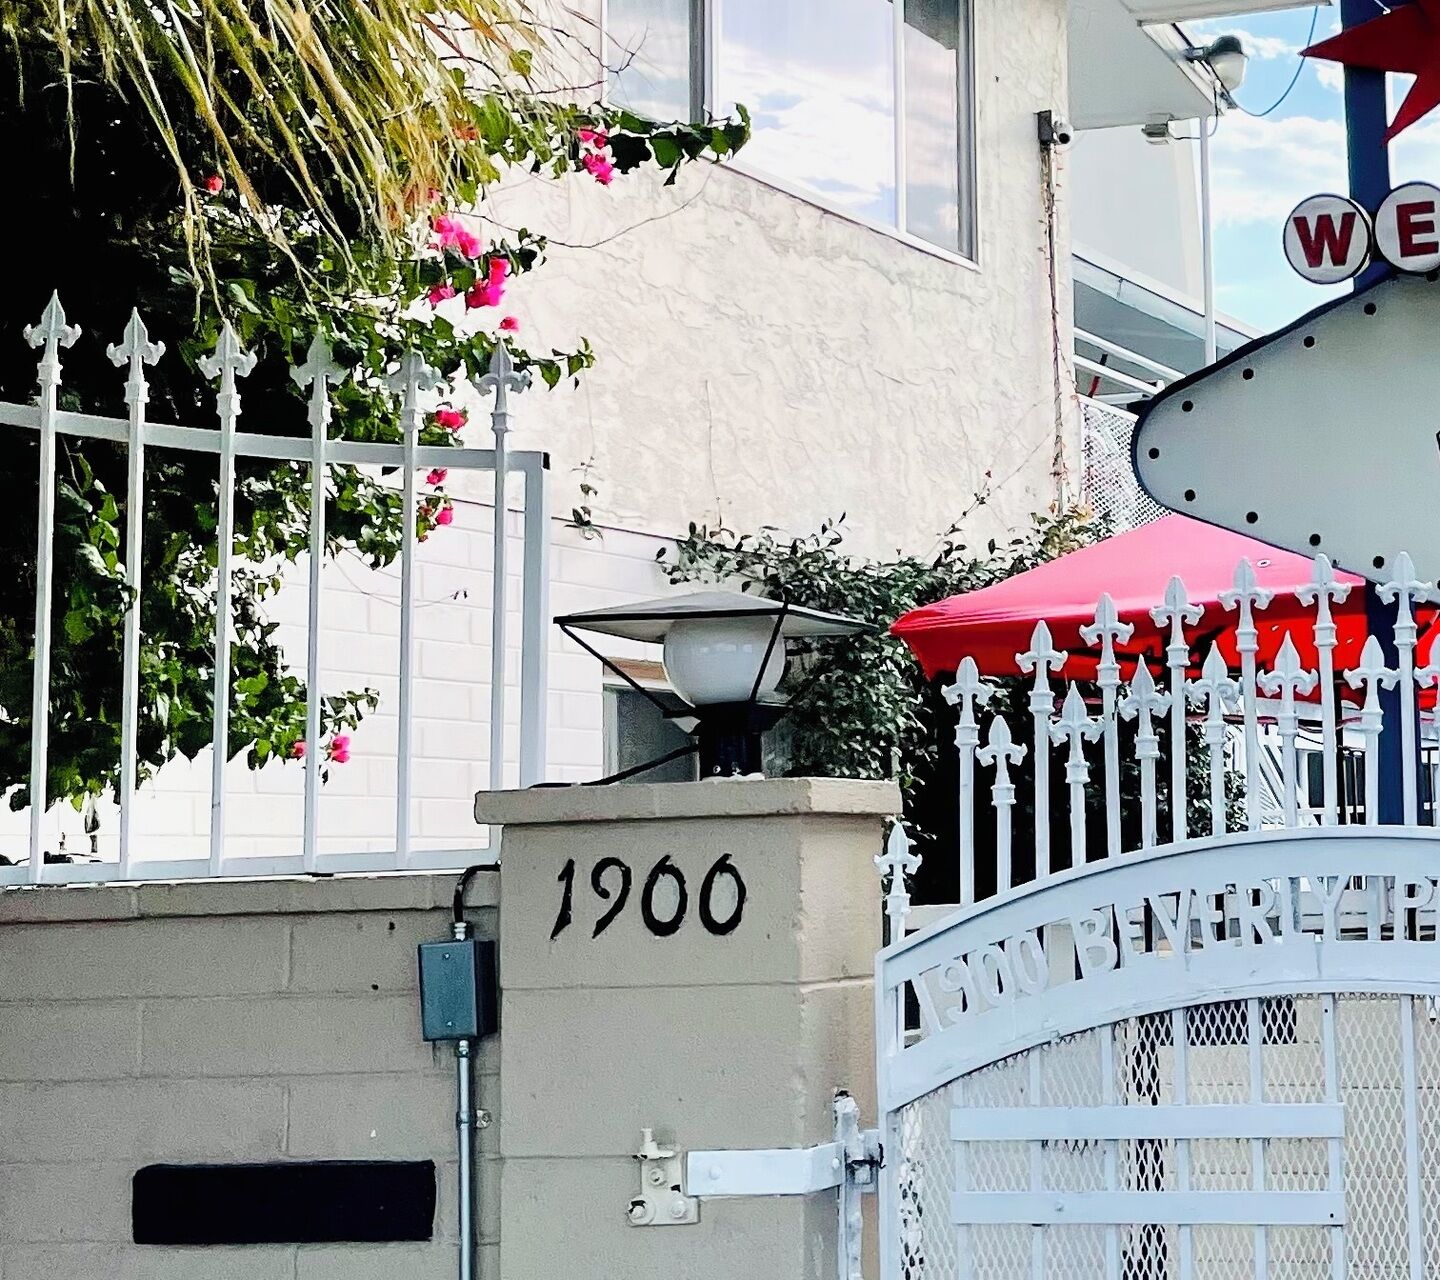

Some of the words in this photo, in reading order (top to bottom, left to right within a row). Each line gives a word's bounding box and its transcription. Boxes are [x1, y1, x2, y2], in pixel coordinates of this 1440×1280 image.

[550, 853, 747, 940] 1900
[912, 928, 1049, 1032] 1900
[1073, 875, 1350, 977] BEVERLY
